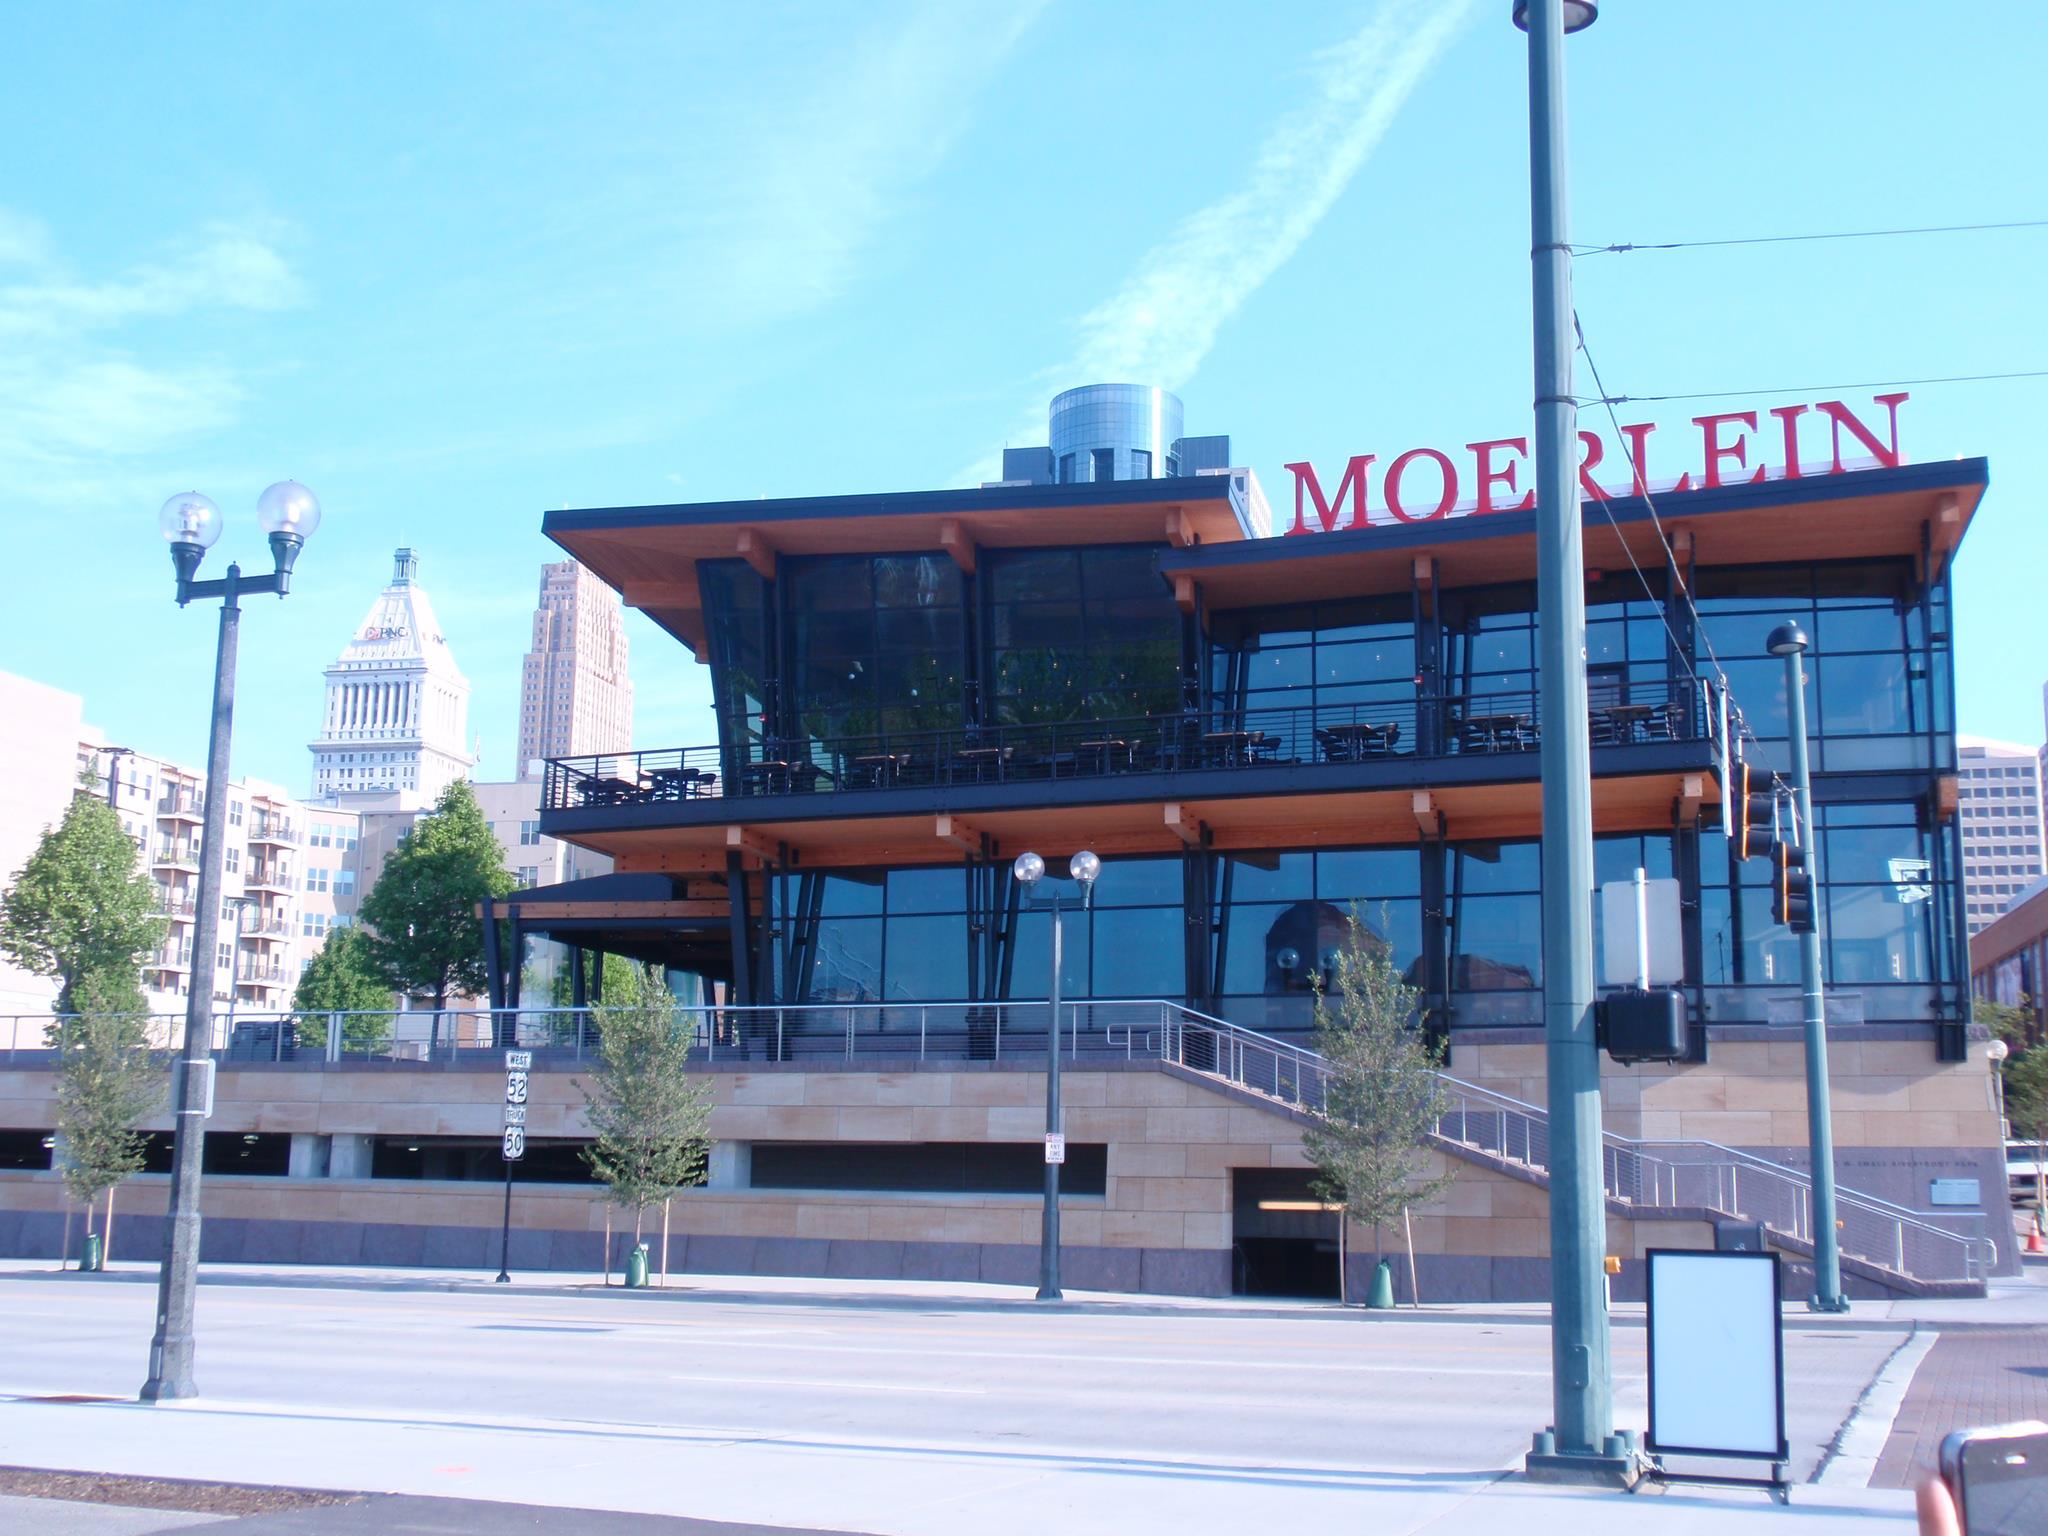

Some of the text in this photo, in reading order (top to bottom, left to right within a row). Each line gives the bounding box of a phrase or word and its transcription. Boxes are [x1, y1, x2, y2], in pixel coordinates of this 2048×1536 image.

[1284, 392, 1910, 537] MOERLEIN
[380, 626, 407, 639] PNC
[511, 1055, 529, 1065] WEST
[509, 1079, 526, 1097] 52
[506, 1134, 522, 1152] 50
